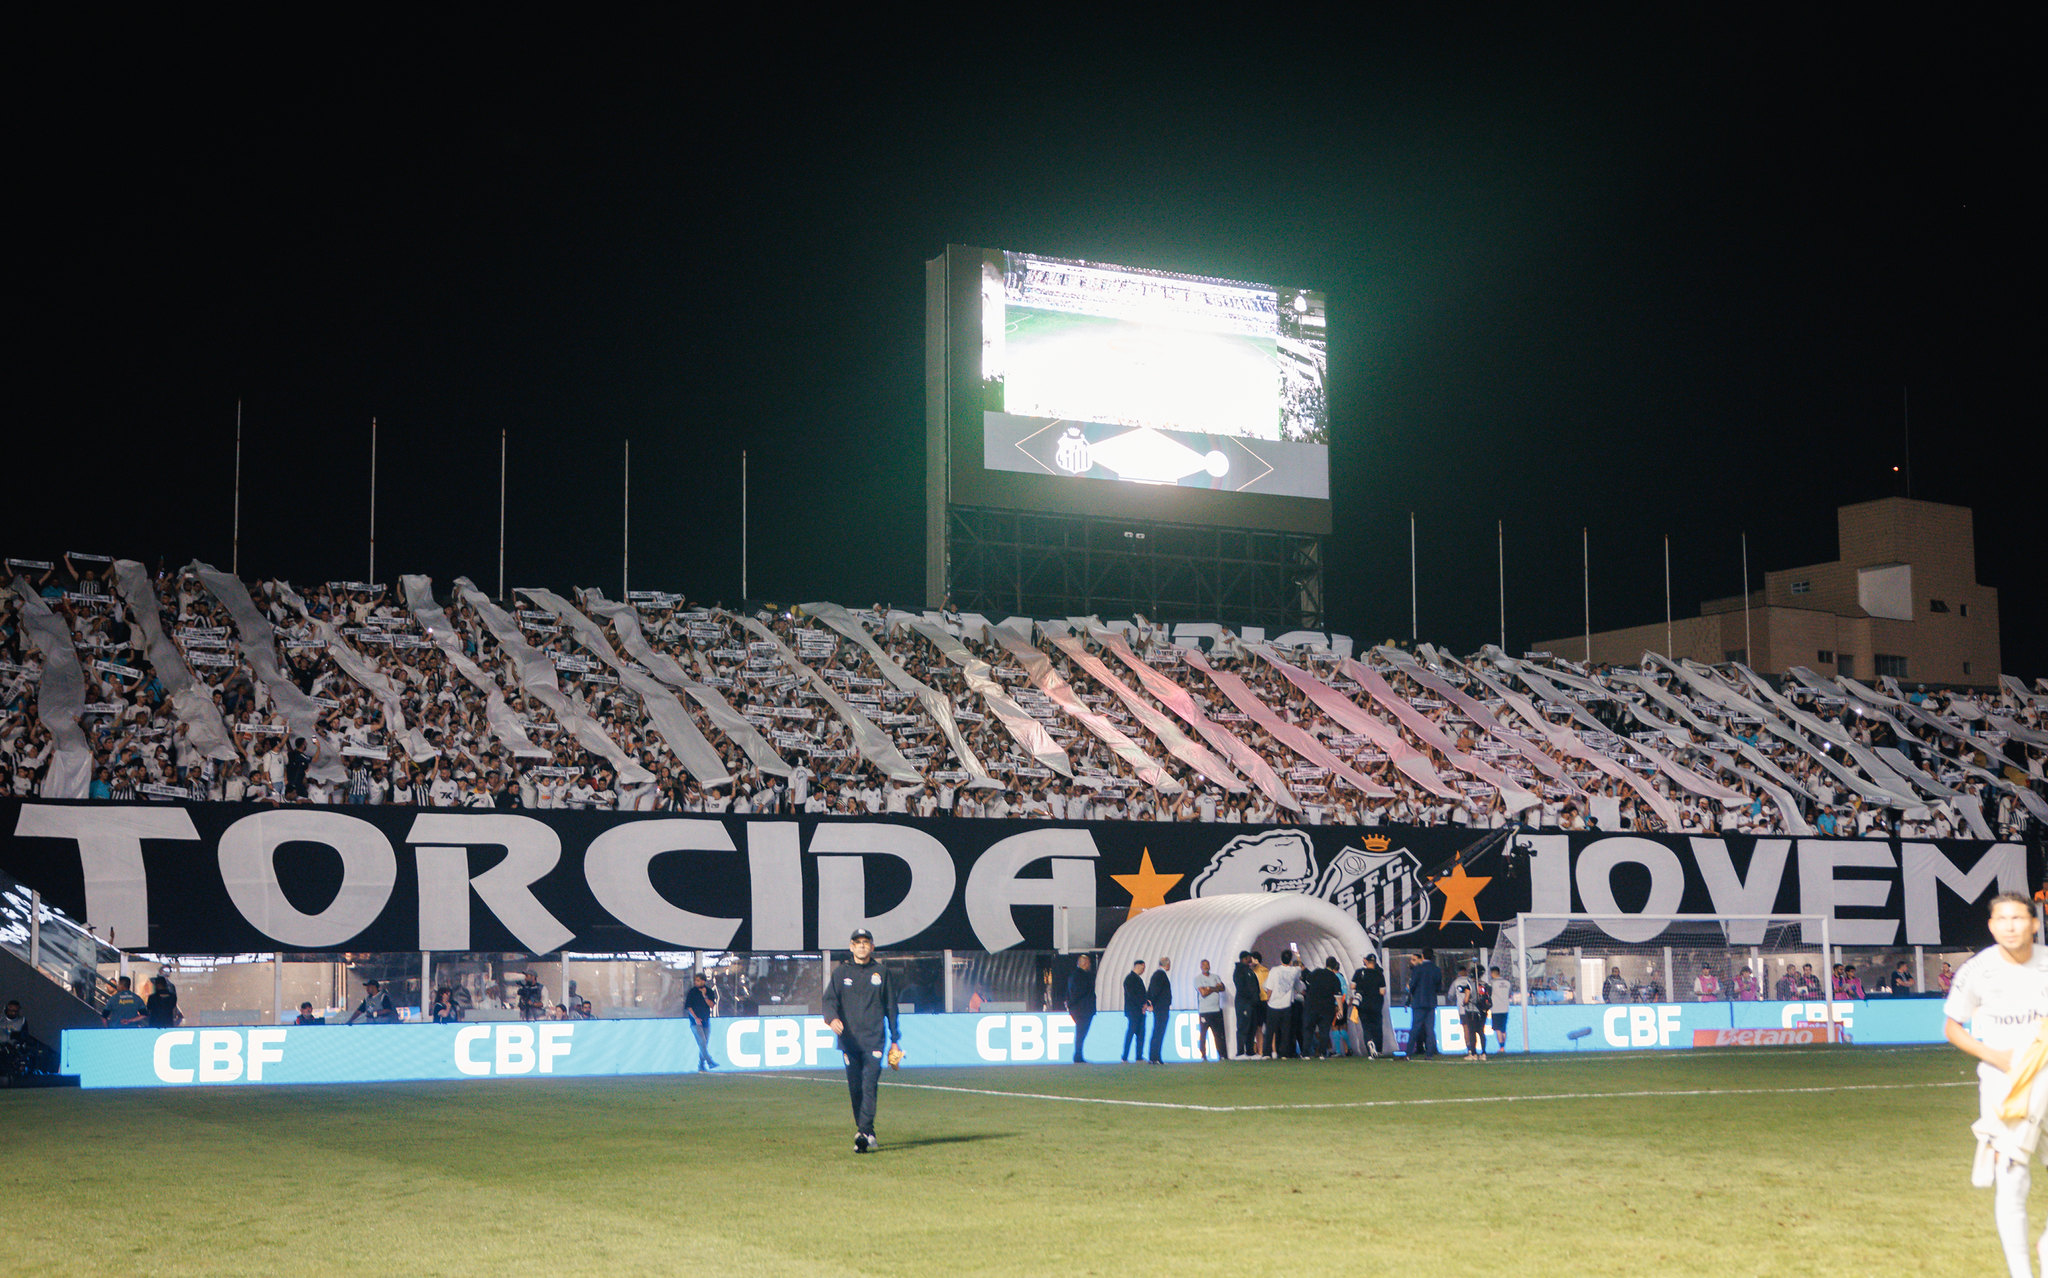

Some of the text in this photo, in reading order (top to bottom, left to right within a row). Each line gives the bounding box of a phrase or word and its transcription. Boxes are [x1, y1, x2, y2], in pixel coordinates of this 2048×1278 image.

[14, 803, 2029, 957] TORCIDA JOVEM
[976, 1015, 1076, 1062] CBF
[1603, 1006, 1682, 1048] CBF
[1715, 1028, 1814, 1046] Betano
[1993, 1008, 2048, 1026] novib
[153, 1028, 288, 1084] CBF
[454, 1023, 575, 1076] CBF
[726, 1018, 835, 1068] CBF
